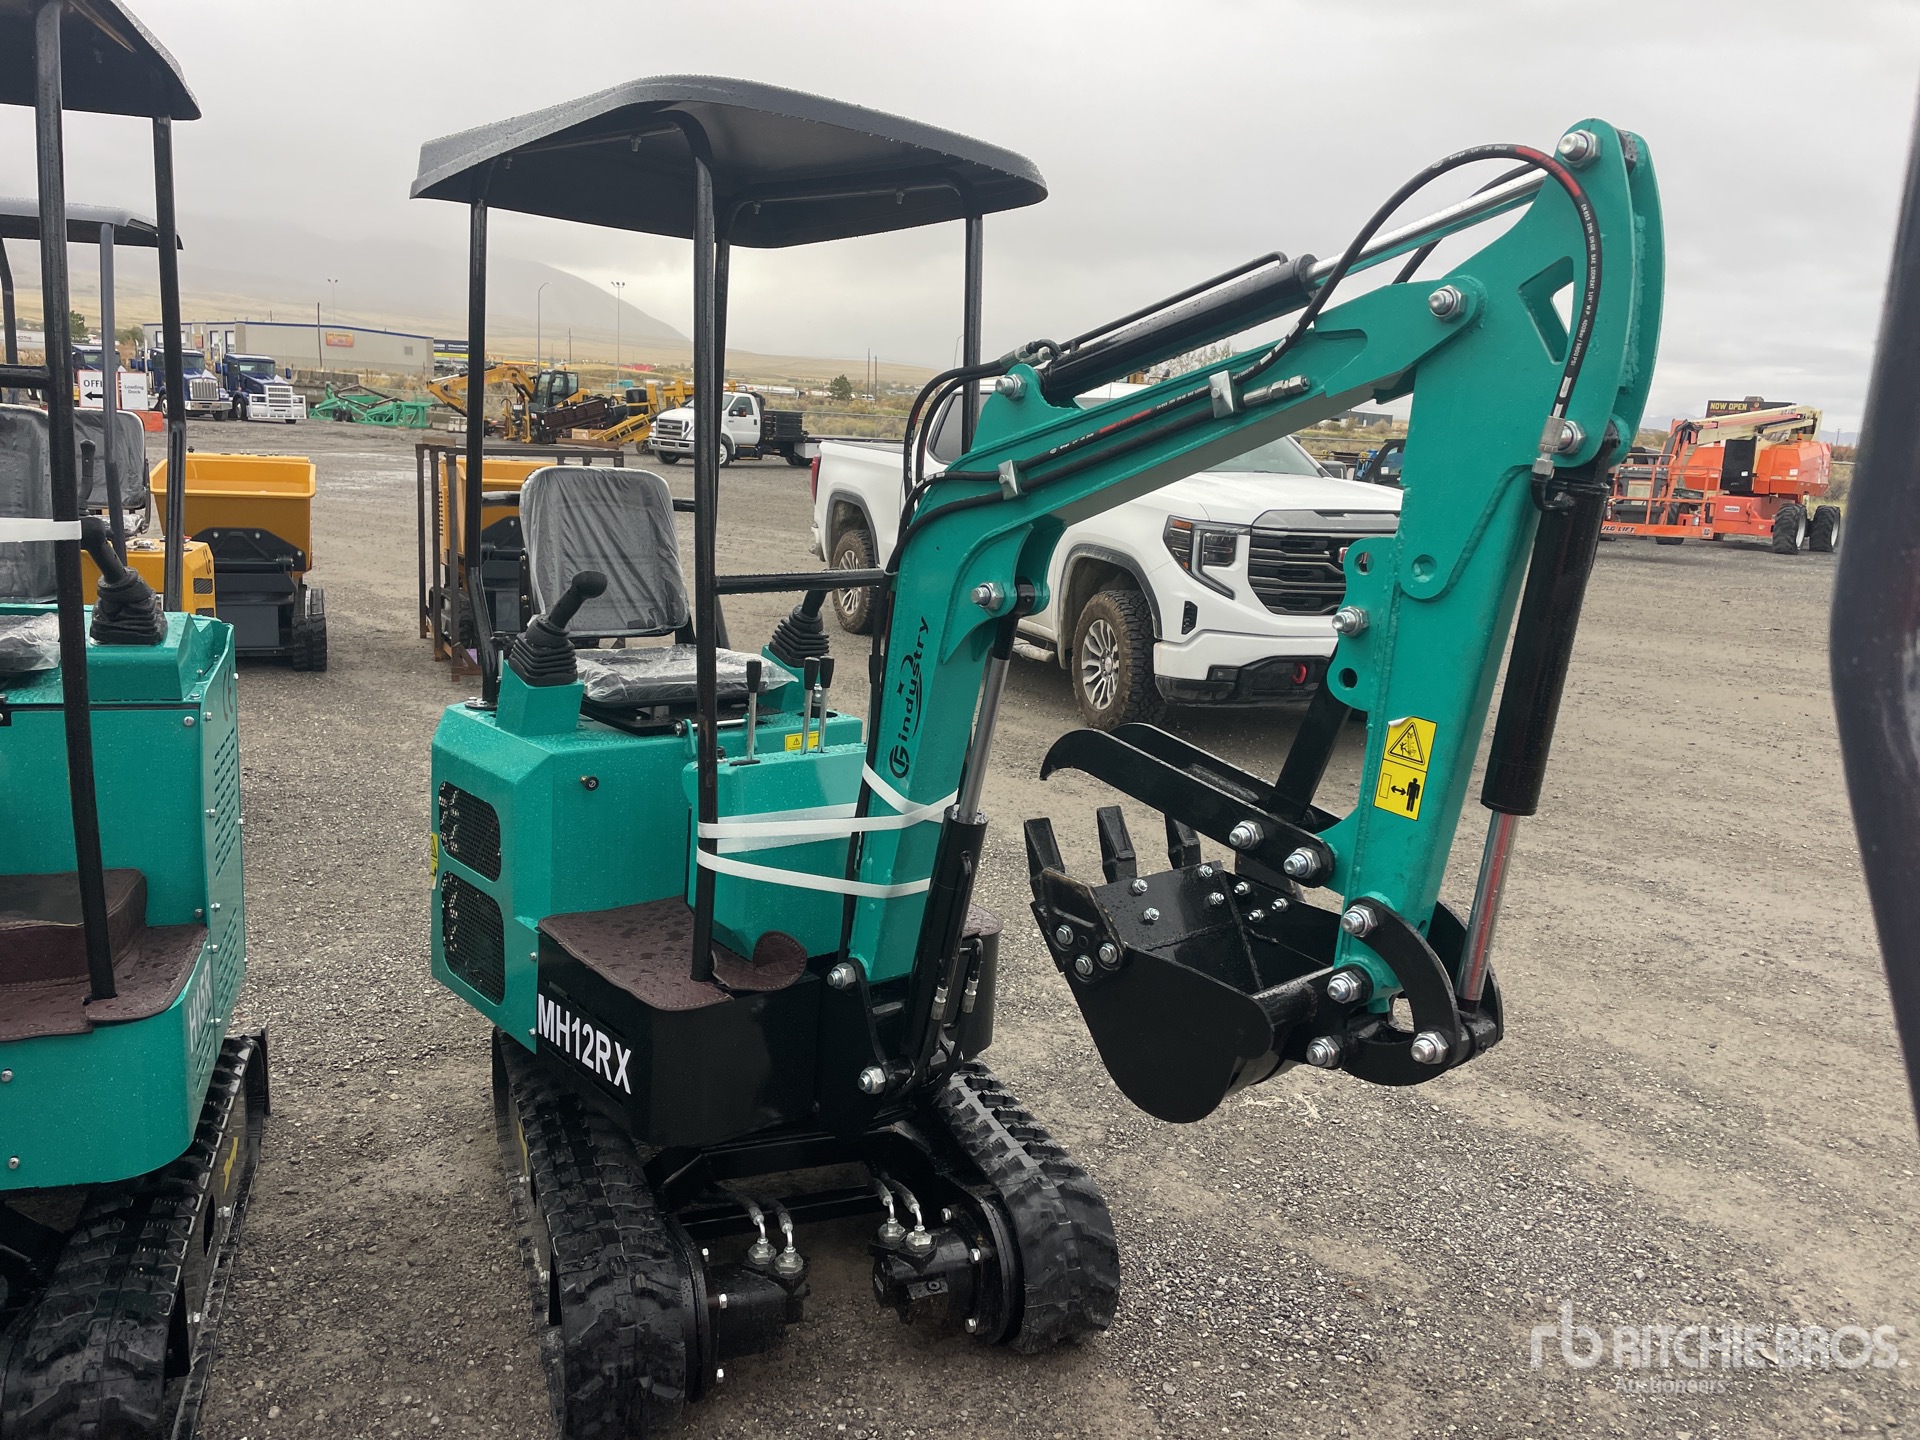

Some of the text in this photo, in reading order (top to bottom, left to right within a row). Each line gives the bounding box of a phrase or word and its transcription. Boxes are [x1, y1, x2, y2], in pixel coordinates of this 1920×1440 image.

[83, 379, 103, 388] OFFI
[1710, 402, 1727, 410] NOW
[1728, 403, 1747, 411] OPEN
[537, 993, 632, 1095] MH12RX
